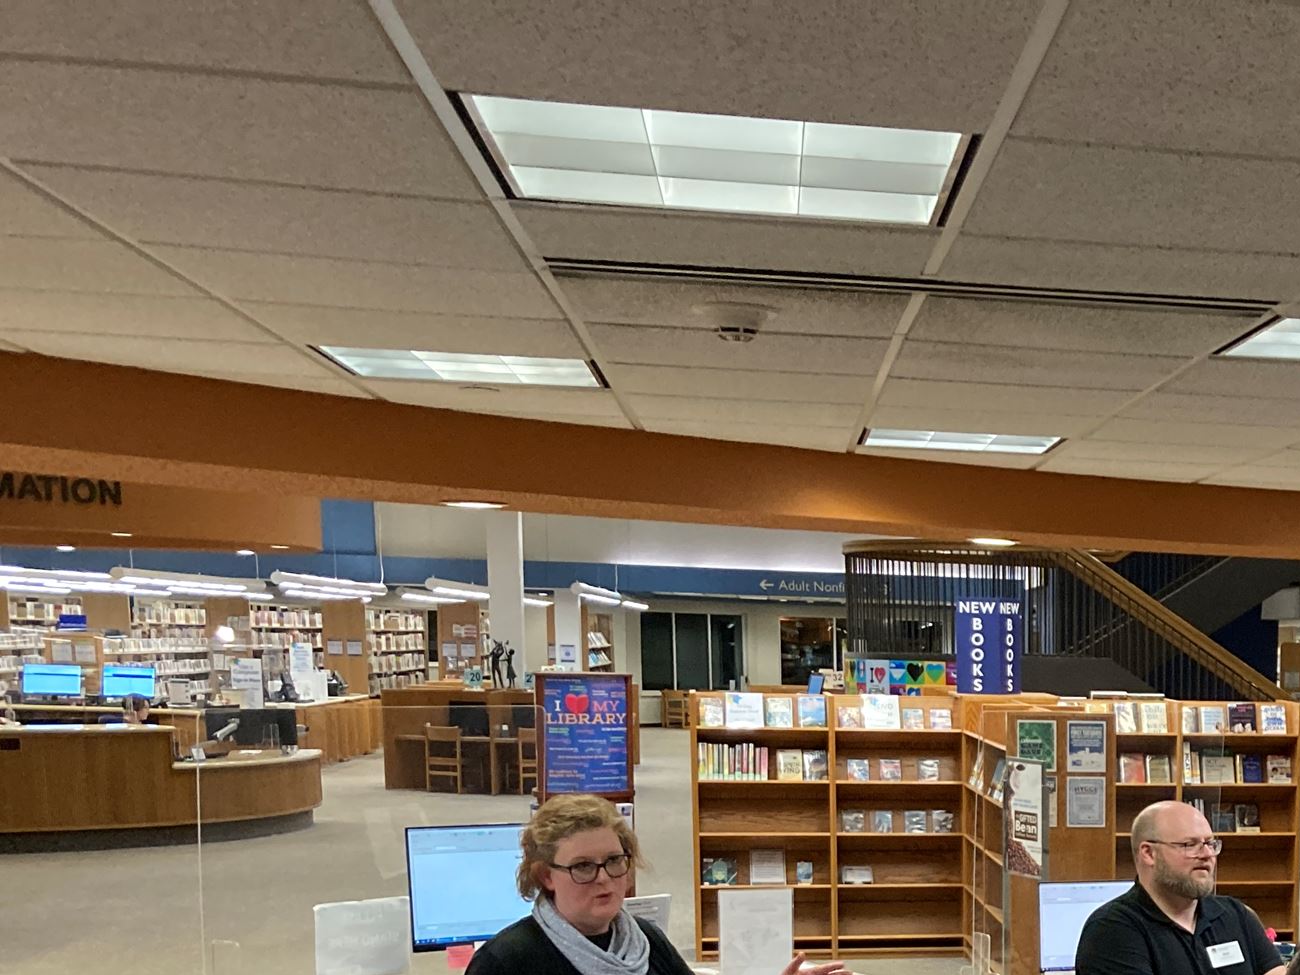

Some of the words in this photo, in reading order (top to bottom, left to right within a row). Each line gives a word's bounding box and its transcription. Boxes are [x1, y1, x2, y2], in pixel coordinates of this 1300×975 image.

[779, 580, 809, 592] Adult
[959, 601, 996, 614] NEW
[1000, 602, 1020, 615] NEW
[971, 617, 985, 692] BOOKS
[1006, 618, 1014, 692] BOOKS
[470, 672, 480, 682] 20
[554, 700, 561, 712] I
[593, 700, 619, 713] MY
[547, 713, 626, 725] LIBRARY
[1015, 820, 1037, 834] Bean
